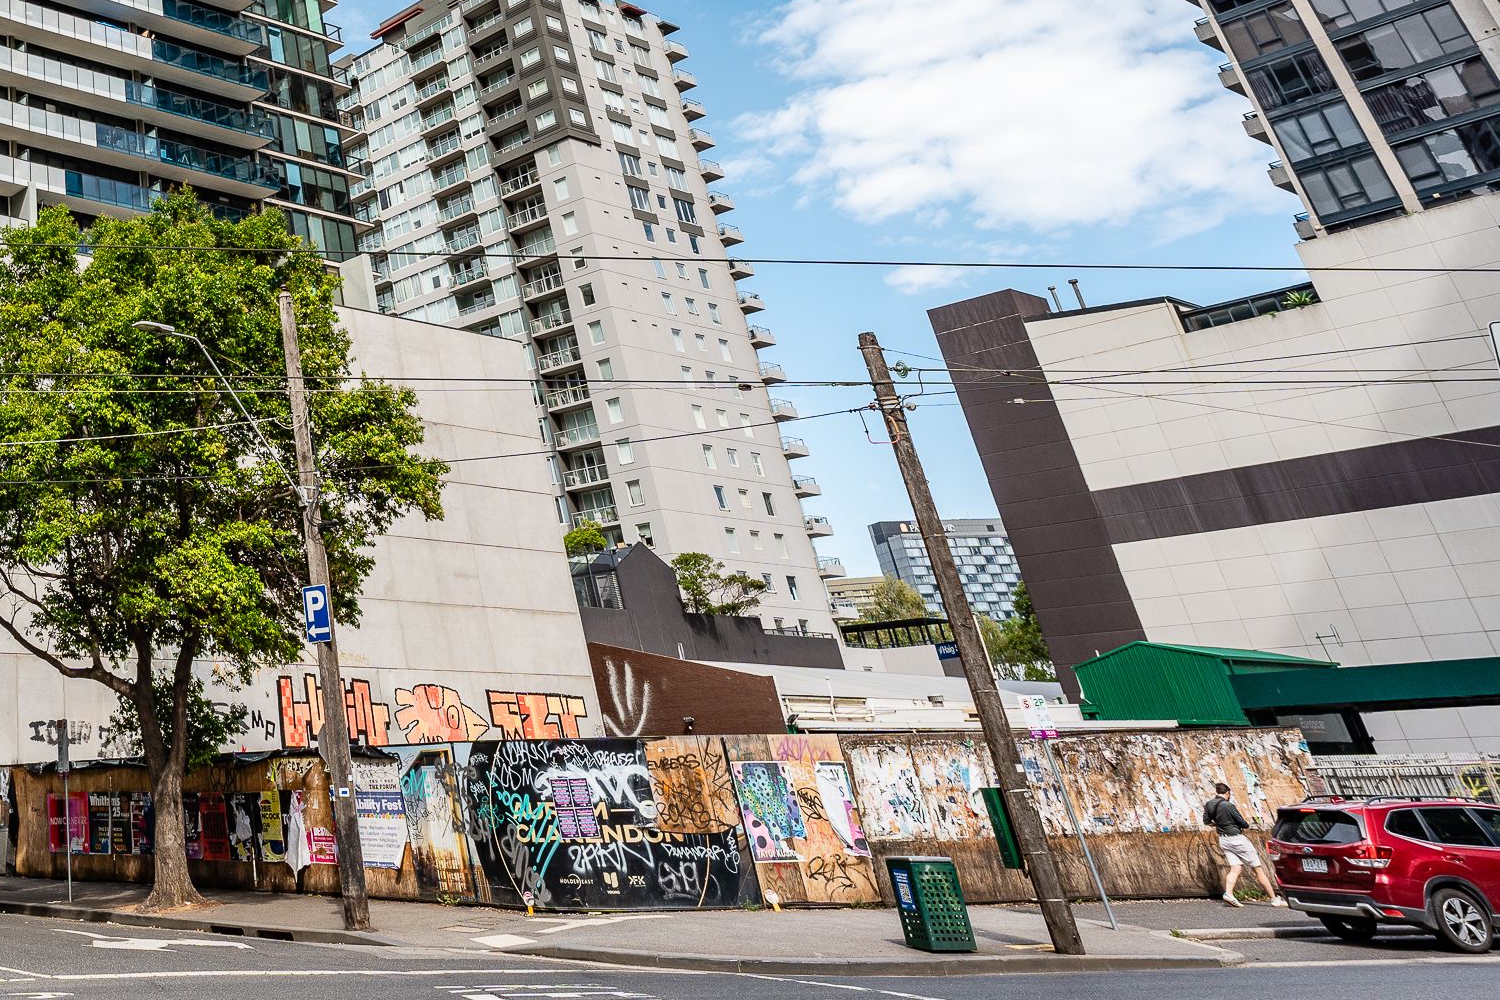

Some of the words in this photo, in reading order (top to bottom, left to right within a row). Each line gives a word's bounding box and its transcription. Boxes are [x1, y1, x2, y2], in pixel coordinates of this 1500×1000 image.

[305, 590, 325, 623] P
[381, 799, 403, 811] Fest
[112, 807, 121, 817] 25
